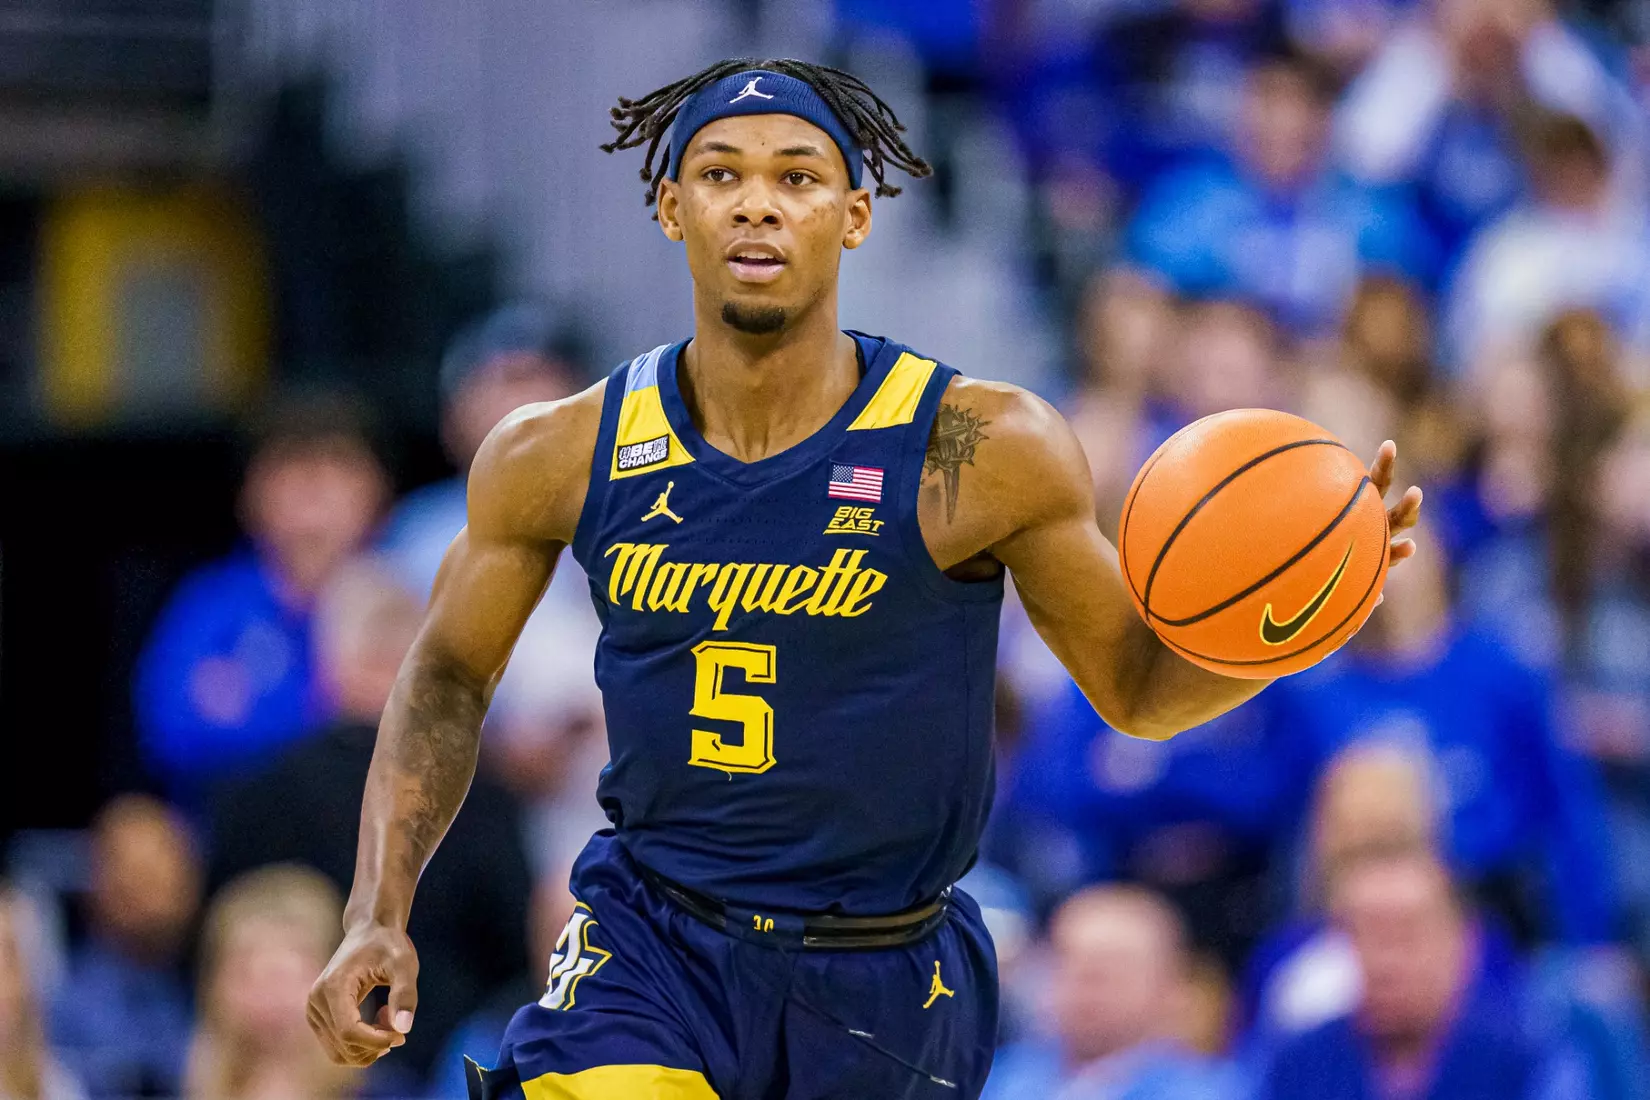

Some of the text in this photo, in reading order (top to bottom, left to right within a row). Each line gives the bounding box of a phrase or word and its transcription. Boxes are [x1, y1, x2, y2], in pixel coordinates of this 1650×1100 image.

[619, 448, 668, 469] CHANGE
[834, 505, 875, 519] BIG
[827, 517, 885, 532] EAST
[604, 542, 888, 631] Marquette
[687, 640, 777, 775] 5
